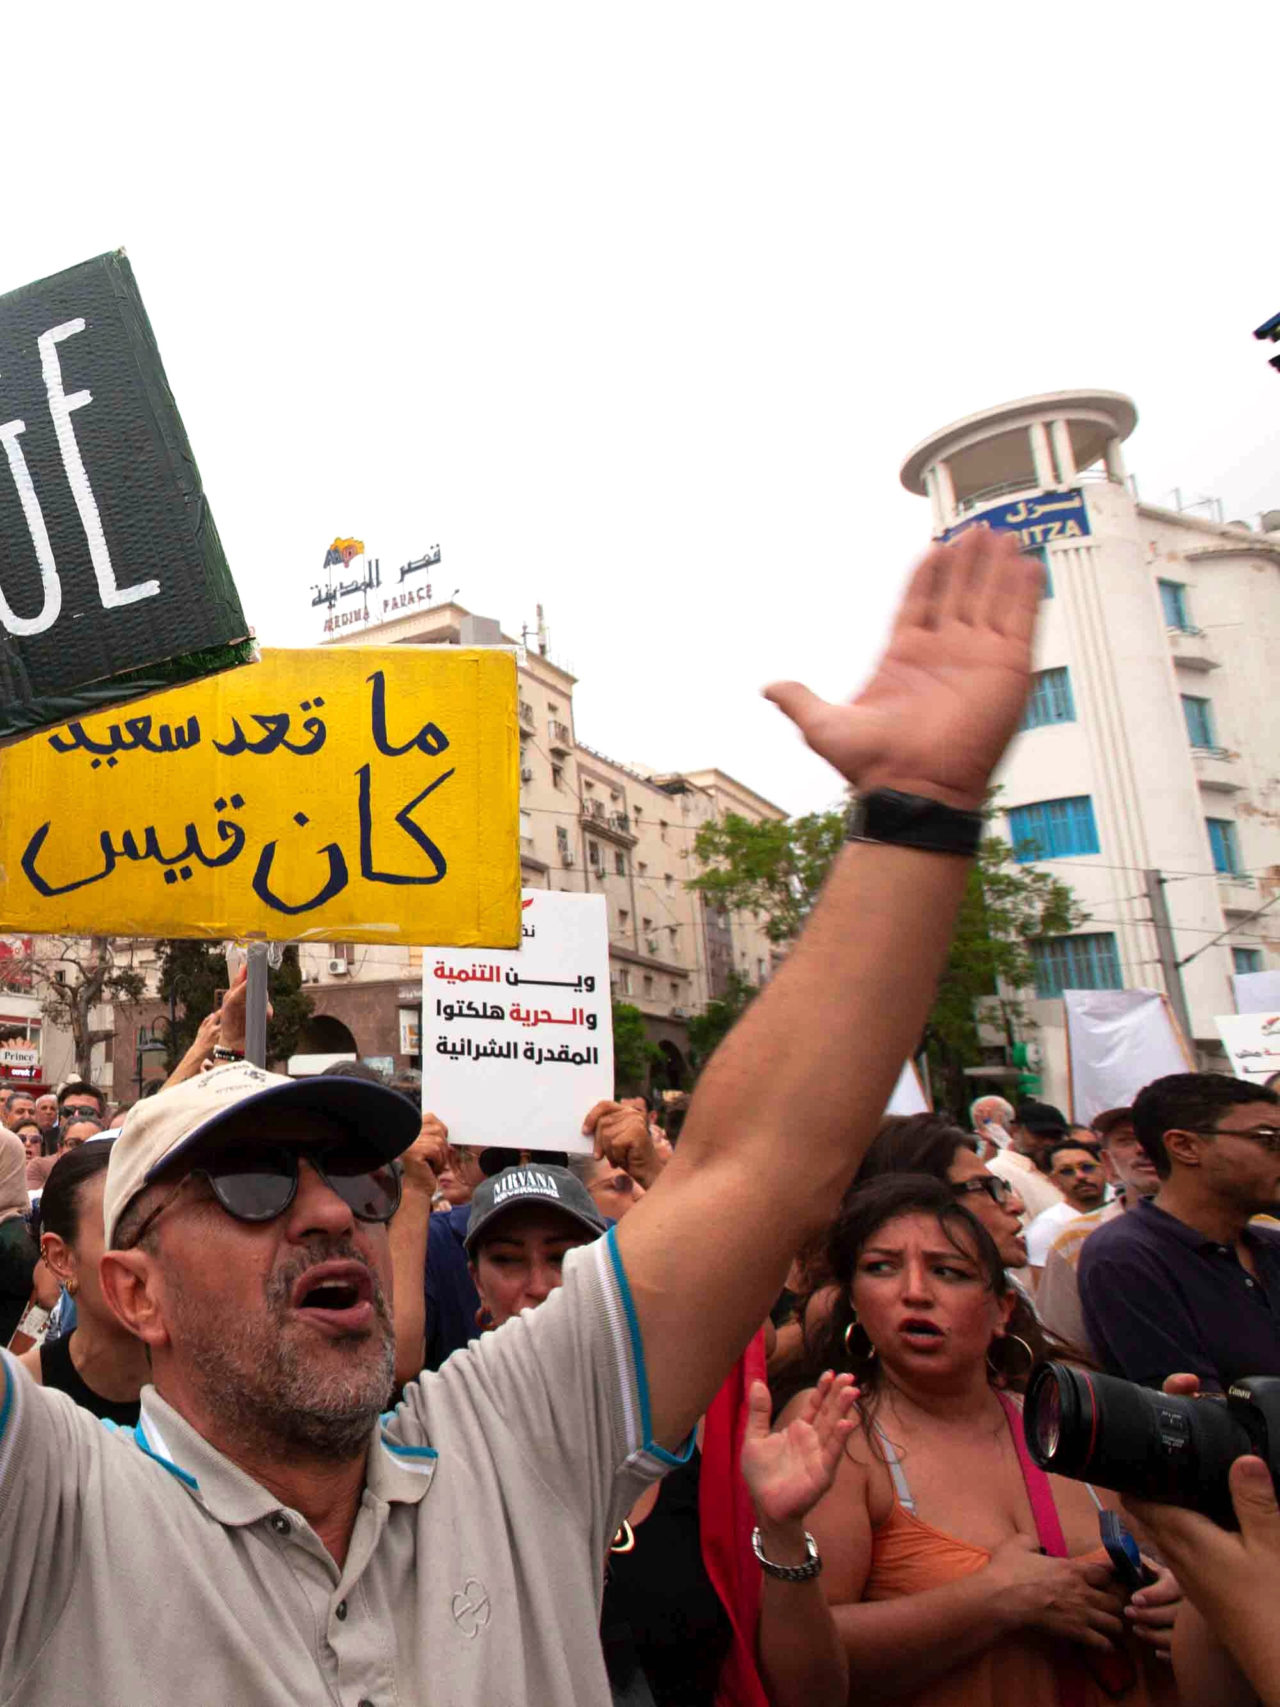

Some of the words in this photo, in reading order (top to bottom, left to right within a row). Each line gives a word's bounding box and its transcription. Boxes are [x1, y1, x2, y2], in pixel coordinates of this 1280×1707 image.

[397, 543, 441, 584] قصر
[311, 558, 382, 609] المدينة
[323, 607, 370, 632] MEDINA
[383, 583, 432, 613] PALACE
[213, 696, 327, 756] قعد
[366, 670, 450, 757] ما
[47, 714, 201, 770] سعيد
[20, 792, 246, 898] قيس
[251, 763, 456, 916] كان
[433, 960, 501, 985] التنمية
[505, 967, 596, 993] وين
[436, 998, 505, 1021] هلكتوا
[509, 1002, 598, 1031] والحرية
[436, 1035, 519, 1061] الشرائية
[523, 1041, 599, 1066] المقدرة
[493, 1170, 558, 1195] NIRVANA
[1228, 1384, 1251, 1399] Canon
